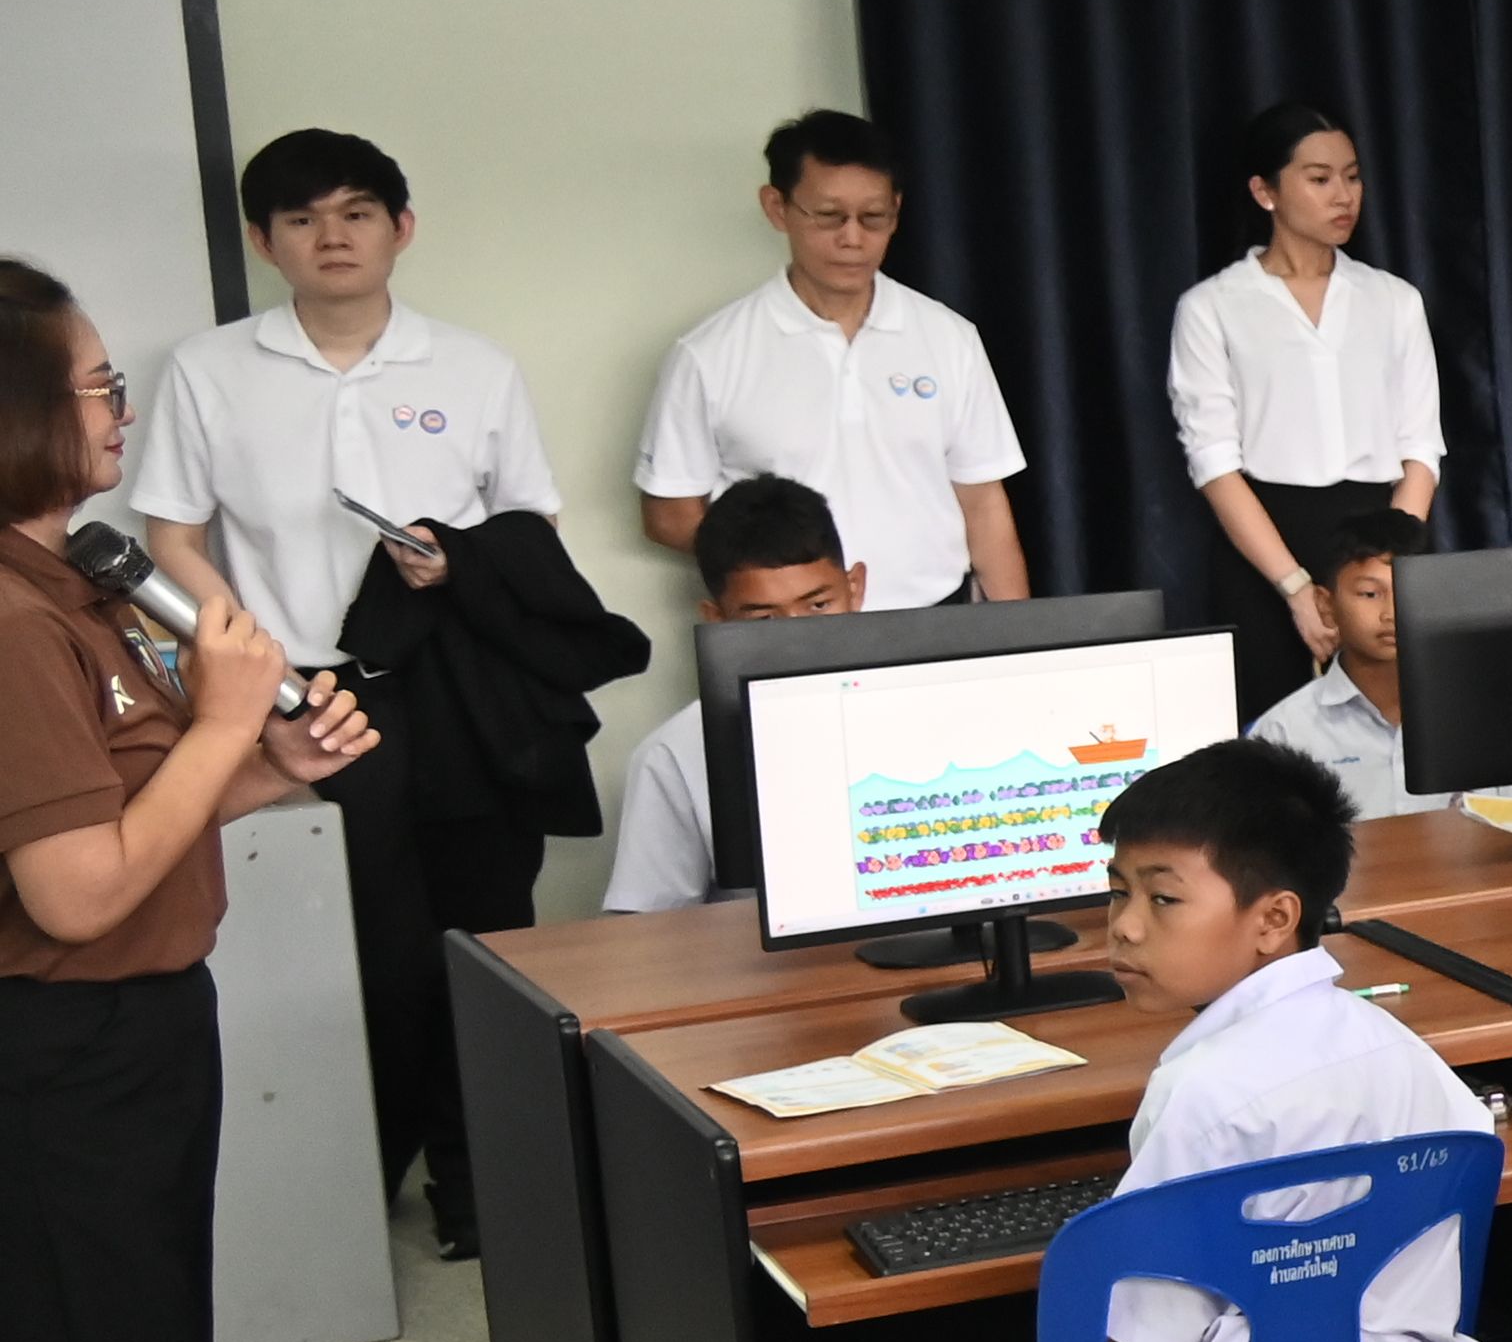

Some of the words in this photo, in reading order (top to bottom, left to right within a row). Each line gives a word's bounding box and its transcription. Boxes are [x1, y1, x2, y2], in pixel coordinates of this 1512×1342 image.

[1397, 1147, 1449, 1173] 81/65
[1251, 1232, 1356, 1265] กองการศึกษาเทศบาล
[1269, 1254, 1339, 1285] ตำบลกรับใหญ่
